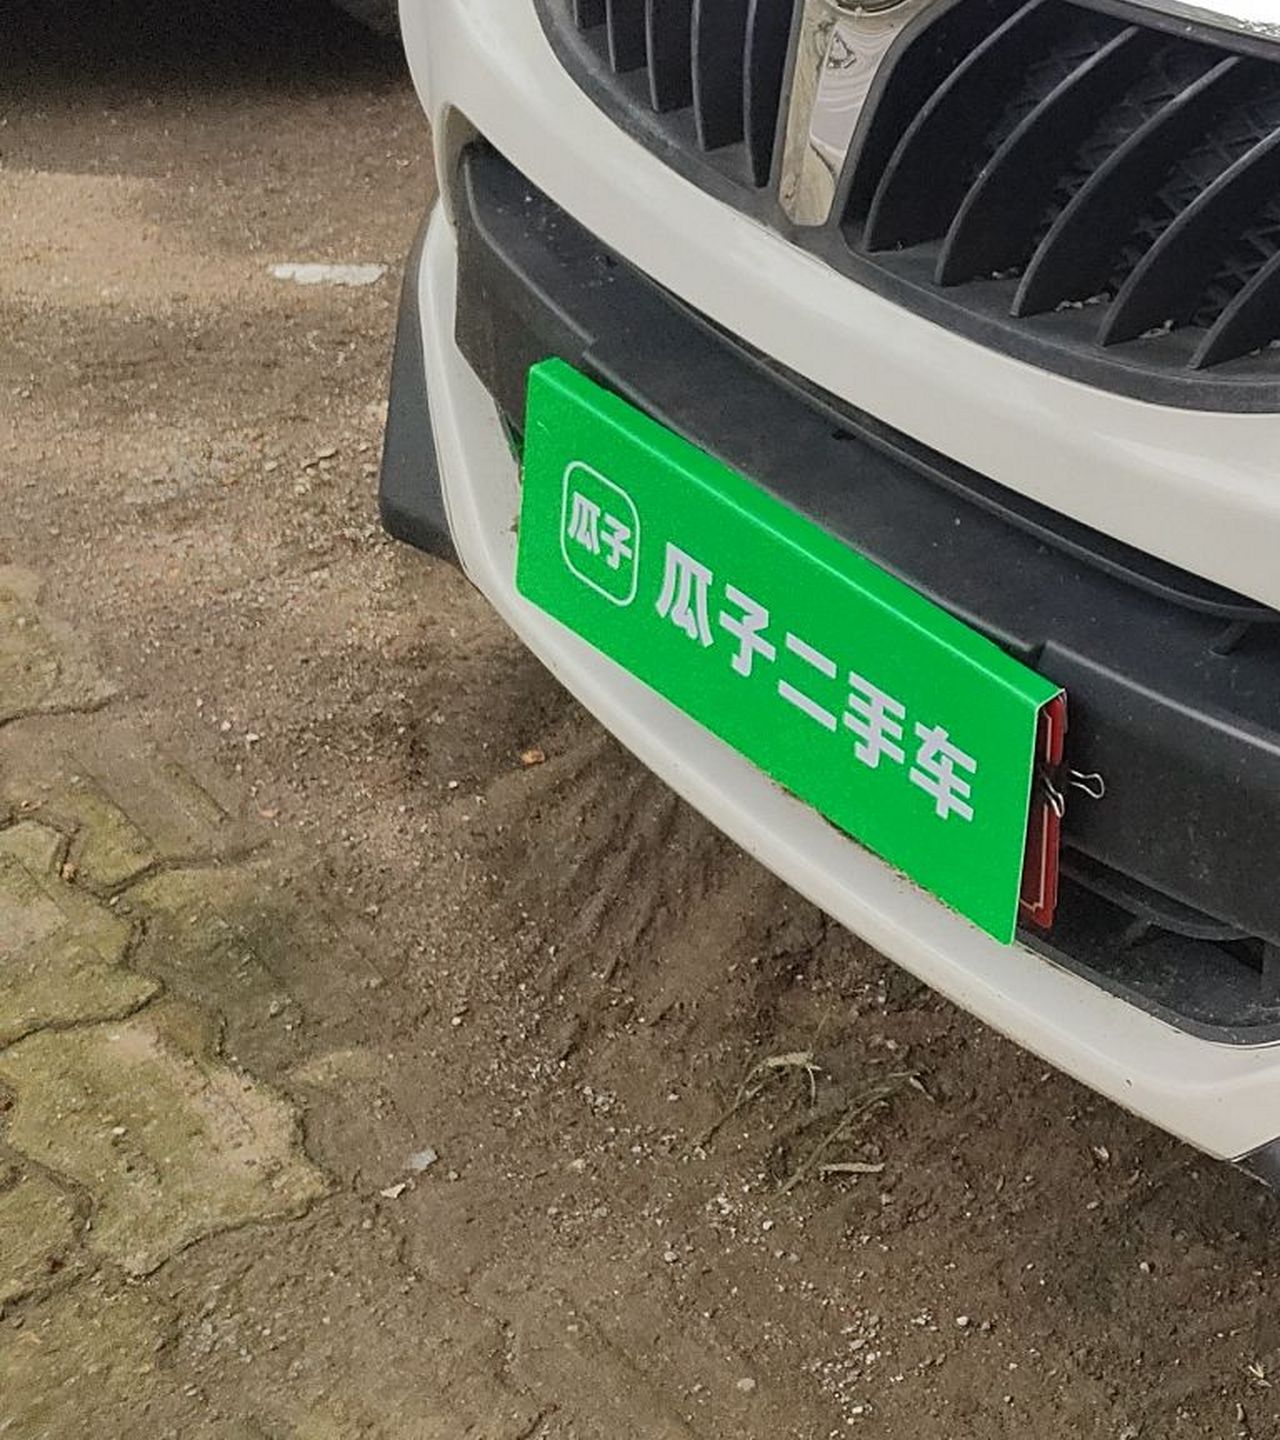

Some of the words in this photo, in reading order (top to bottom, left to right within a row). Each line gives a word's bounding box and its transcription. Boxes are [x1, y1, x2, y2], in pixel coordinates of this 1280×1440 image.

[567, 491, 633, 571] 瓜子
[655, 541, 978, 823] 瓜子二手车
